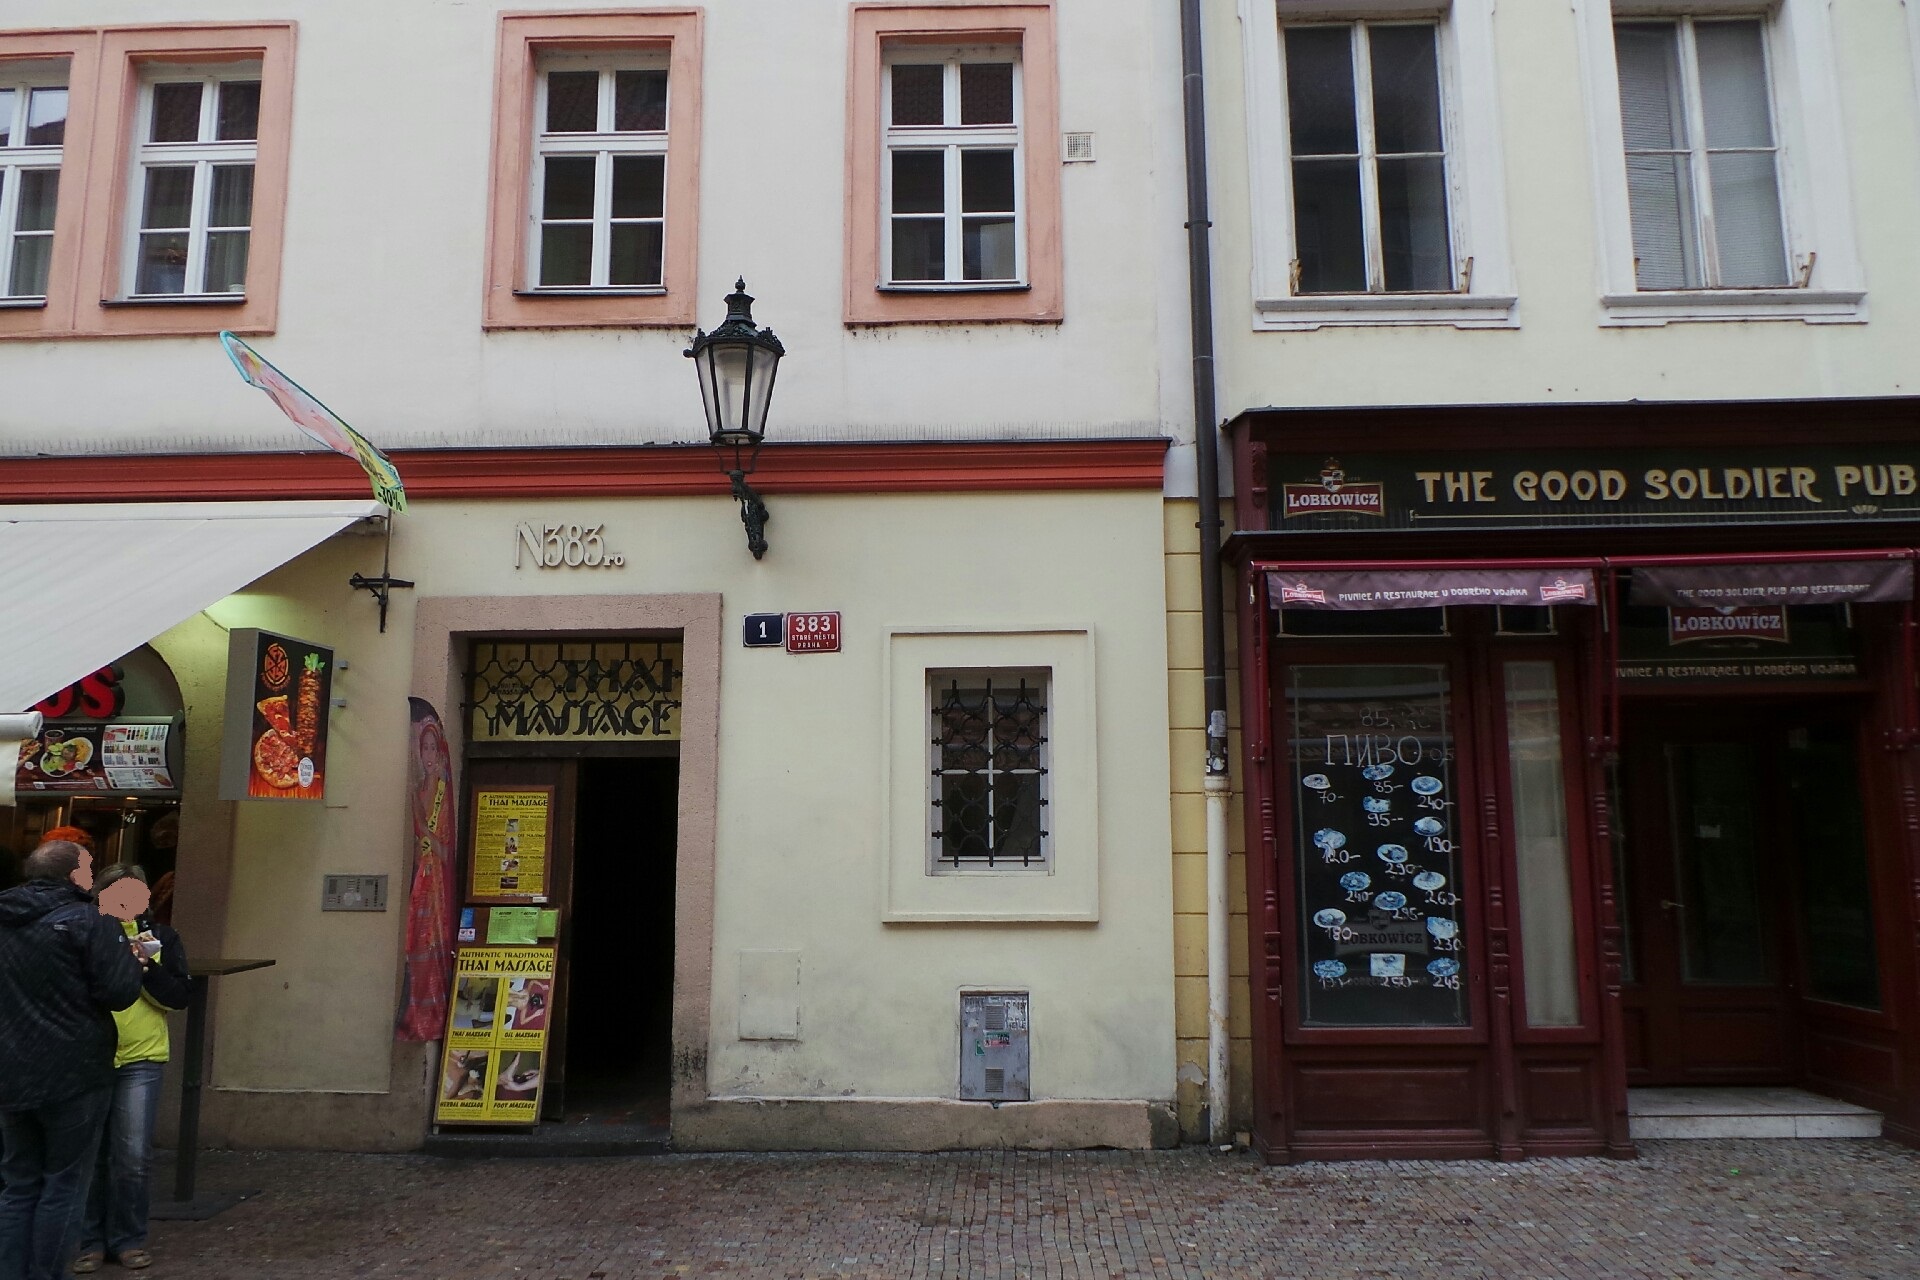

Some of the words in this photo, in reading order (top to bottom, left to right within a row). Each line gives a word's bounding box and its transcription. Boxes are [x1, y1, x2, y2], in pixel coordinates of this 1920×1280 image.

[1415, 471, 1496, 503] THE
[1512, 470, 1627, 502] GOOD
[1644, 467, 1822, 503] SOLDIER
[1834, 464, 1917, 497] PUB
[1288, 492, 1379, 507] LOBKOWICZ
[1339, 593, 1372, 602] PIVNICE
[1375, 592, 1381, 600] A
[1384, 590, 1440, 601] RESTAURACE
[1441, 589, 1449, 597] U
[1493, 587, 1528, 597] VOJÁKA
[1725, 587, 1765, 597] SOLDIER
[1768, 586, 1787, 595] PUB
[796, 615, 831, 633] 383
[1674, 612, 1781, 632] LOBKOWICZ
[759, 621, 767, 639] 1
[791, 632, 812, 641] STARÉ
[798, 641, 820, 649] PRAHA
[560, 658, 673, 693] THAI
[1656, 666, 1664, 677] A
[1667, 665, 1741, 678] RESTAURACE
[1742, 665, 1752, 676] U
[489, 700, 672, 736] MASSAGE
[1325, 733, 1423, 768] ПИВО
[511, 799, 548, 807] MASSAGE
[460, 951, 501, 959] AUTHENTIC
[504, 951, 554, 960] TRADITIONAL
[459, 959, 490, 972] THAI
[494, 959, 553, 973] MASSAGE
